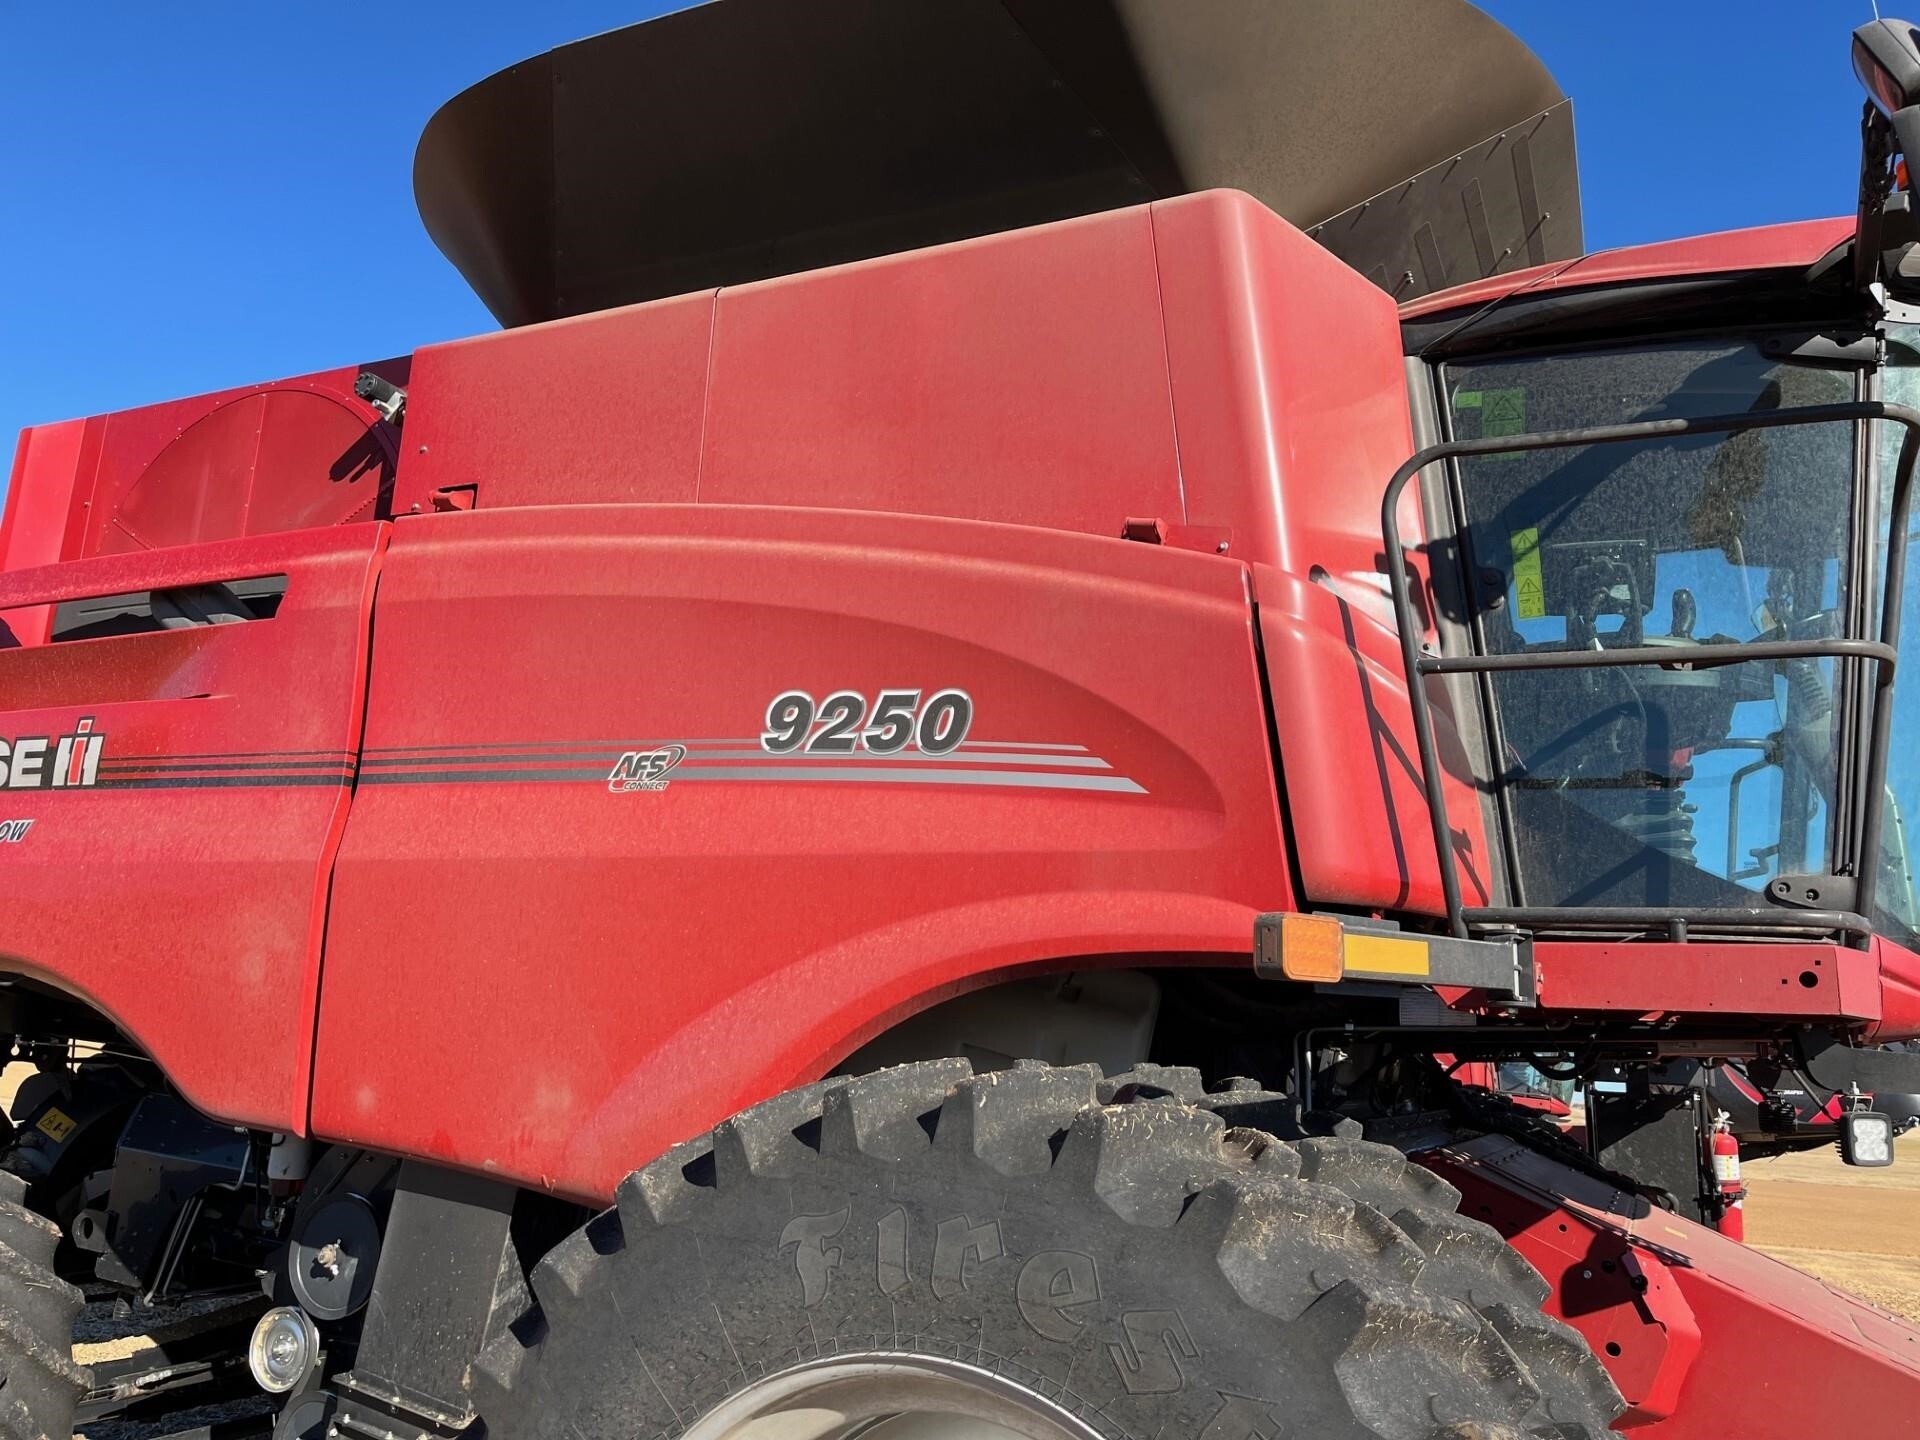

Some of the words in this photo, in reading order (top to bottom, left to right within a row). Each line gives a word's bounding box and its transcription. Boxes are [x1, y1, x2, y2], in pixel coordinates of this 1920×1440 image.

[761, 689, 973, 755] 9250
[608, 751, 671, 780] AFS
[624, 780, 669, 791] CONNECT
